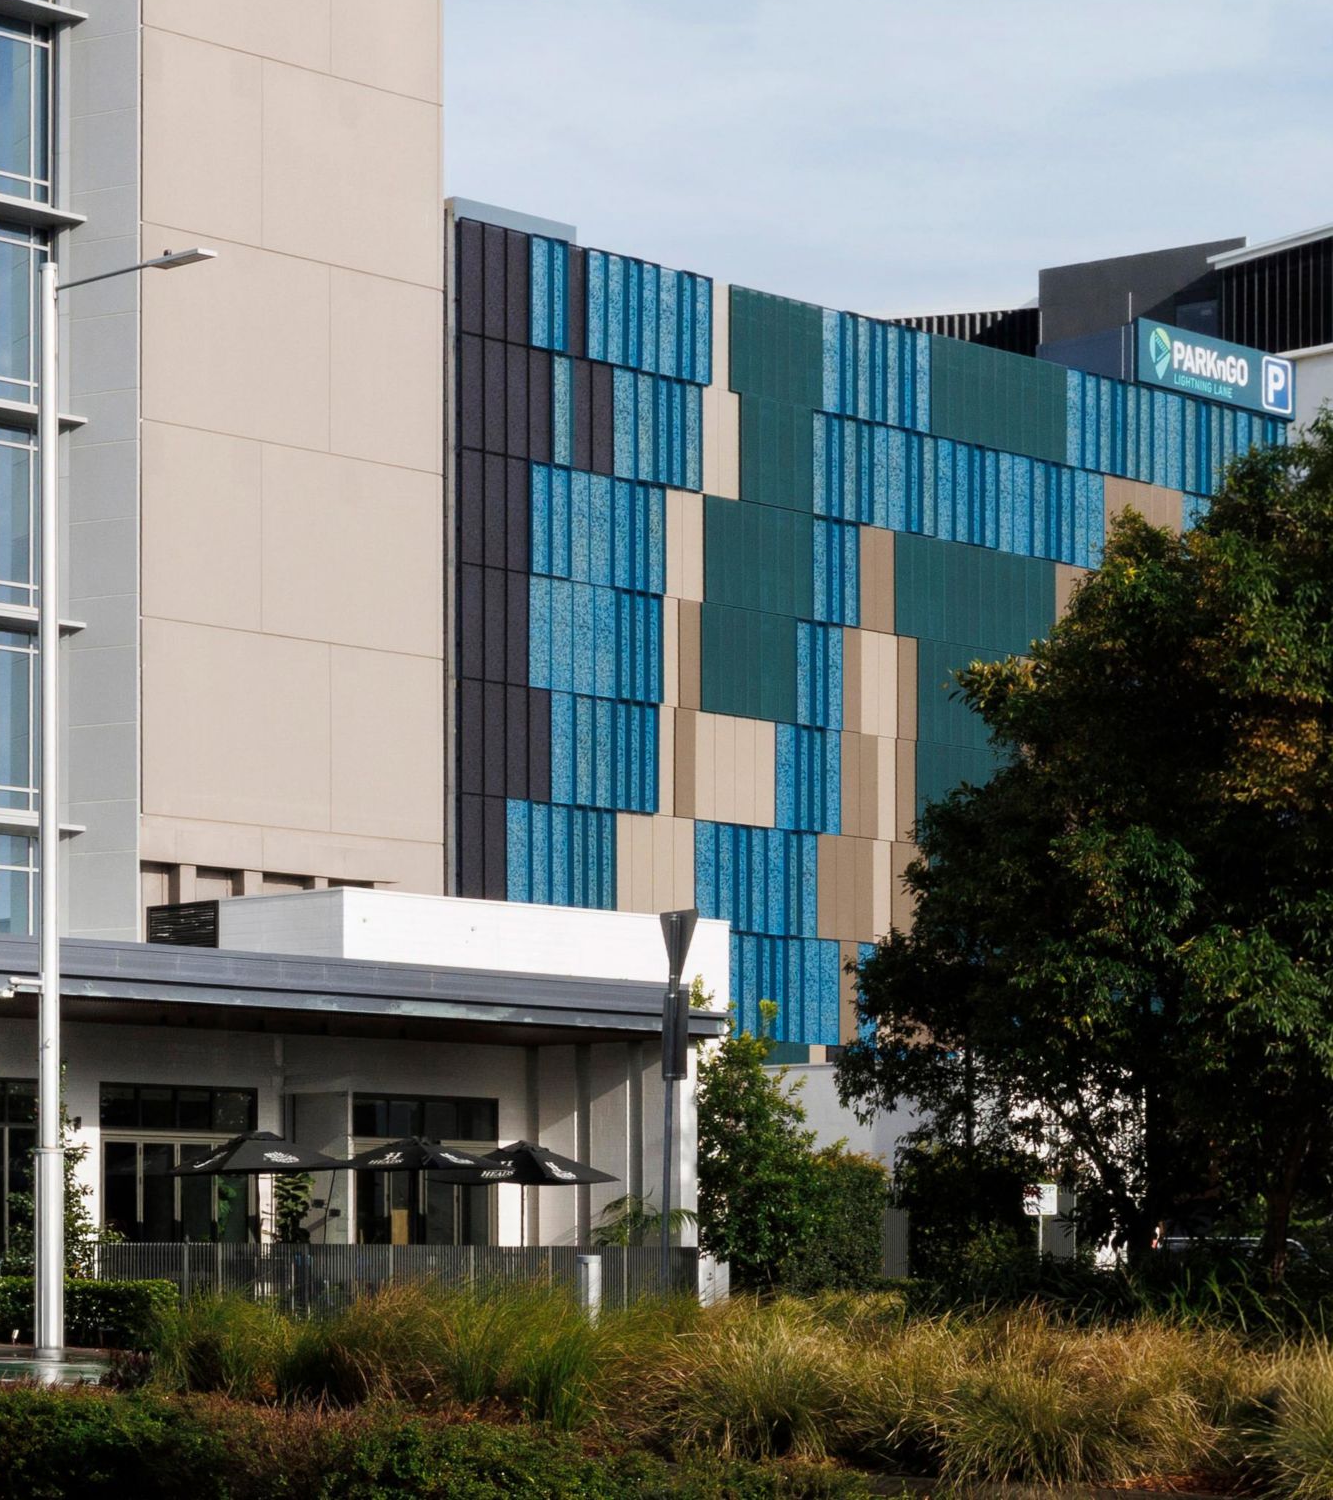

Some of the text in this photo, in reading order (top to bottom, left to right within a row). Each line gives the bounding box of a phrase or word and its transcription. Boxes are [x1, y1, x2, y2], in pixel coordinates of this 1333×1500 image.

[1173, 340, 1249, 388] PARKnGO
[1173, 373, 1233, 399] LIGHTNING LANE
